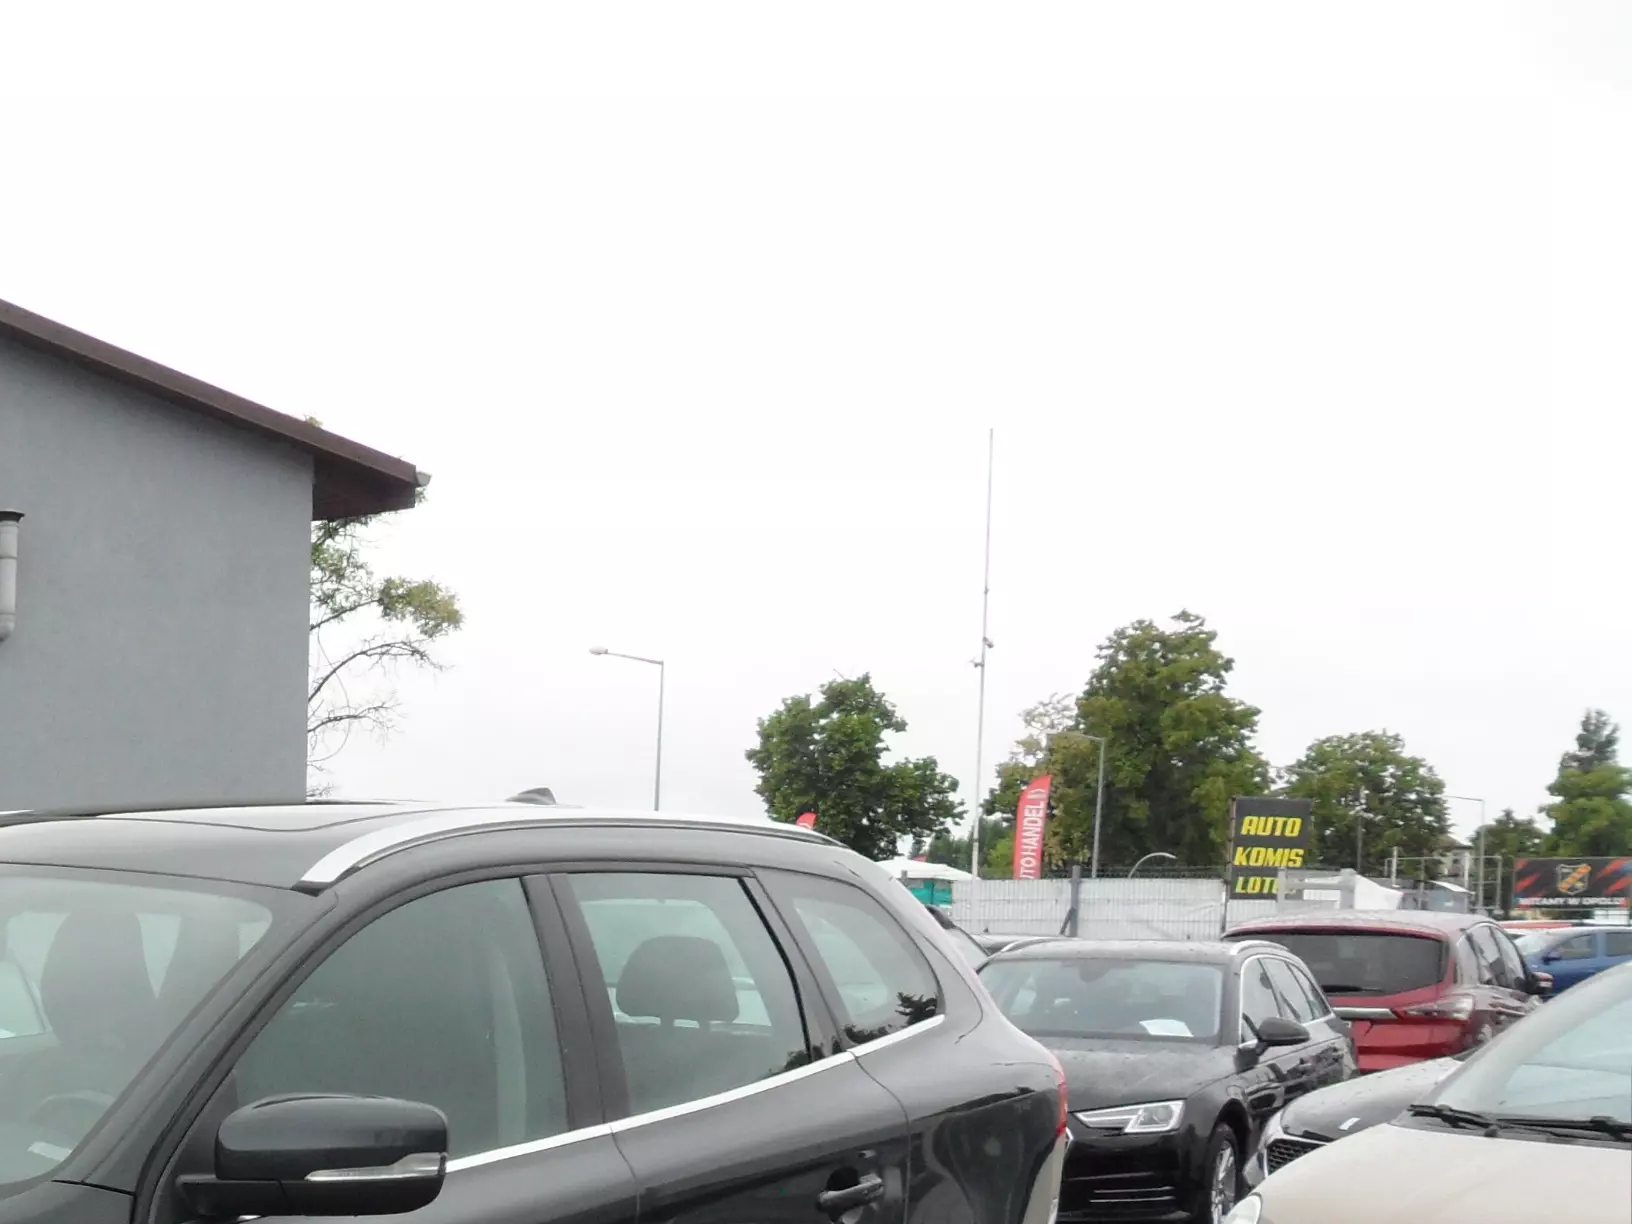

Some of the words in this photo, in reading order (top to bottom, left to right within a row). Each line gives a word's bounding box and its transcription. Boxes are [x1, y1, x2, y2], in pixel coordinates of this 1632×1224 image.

[1241, 815, 1302, 837] AUTO
[1234, 846, 1304, 868] KOMIS
[1235, 876, 1296, 895] LOT
